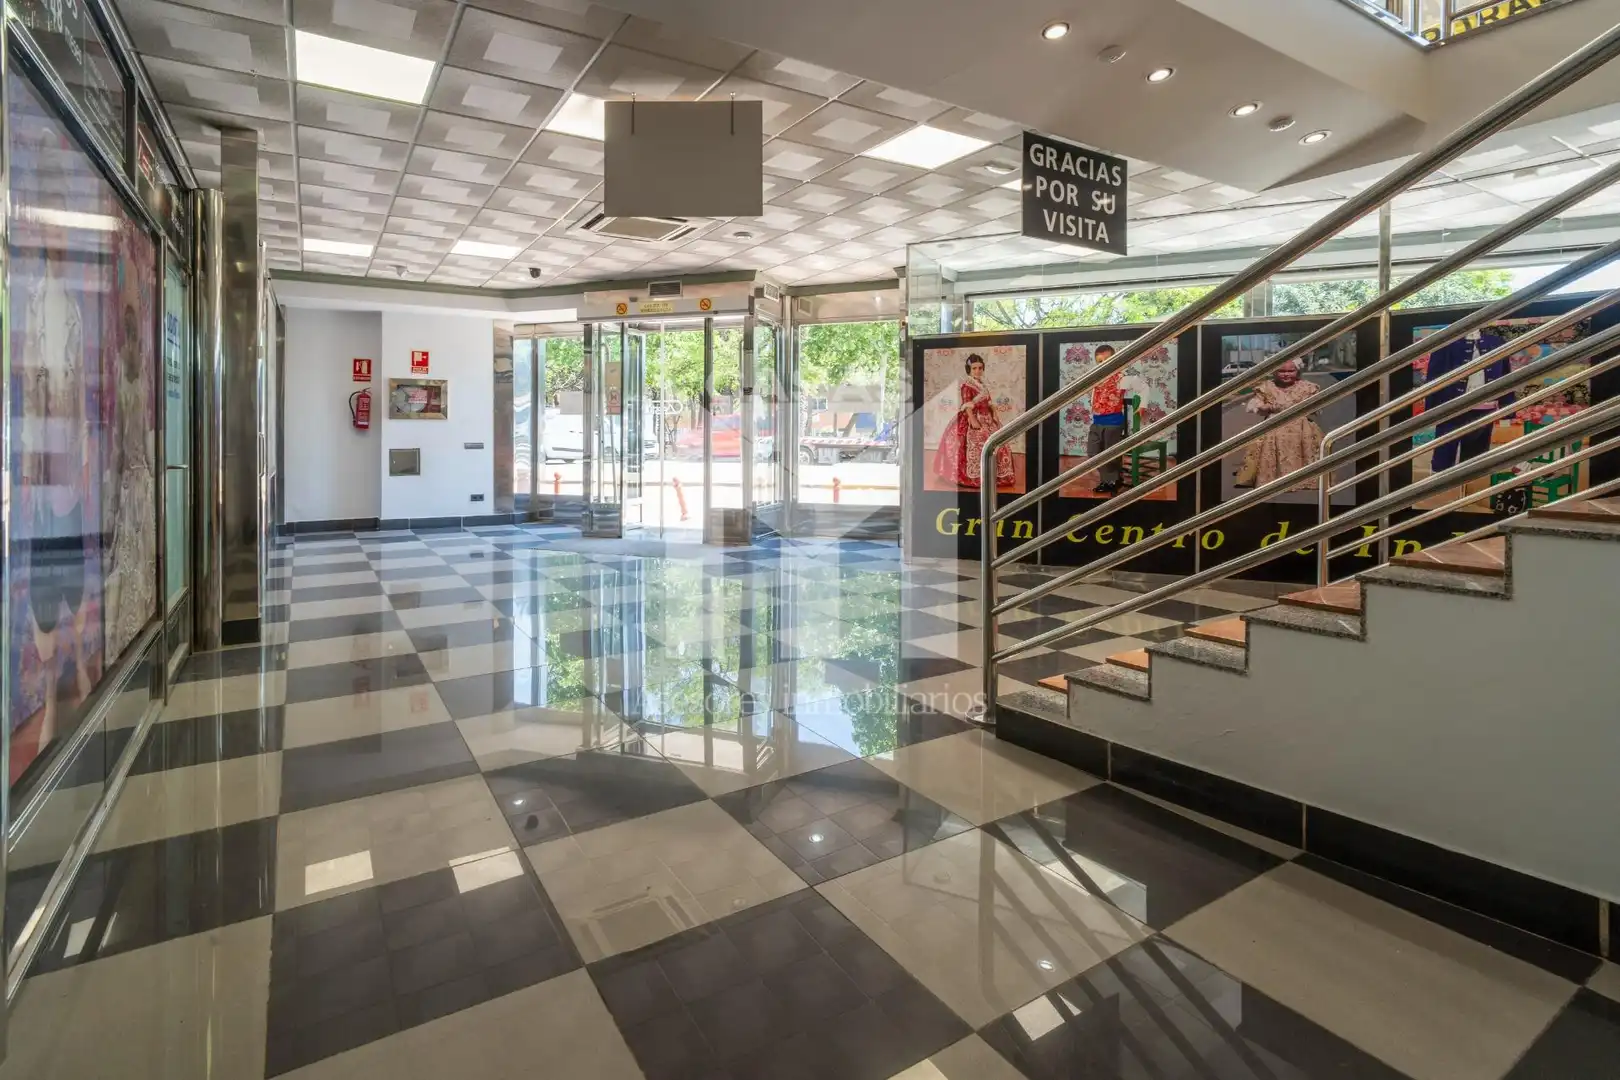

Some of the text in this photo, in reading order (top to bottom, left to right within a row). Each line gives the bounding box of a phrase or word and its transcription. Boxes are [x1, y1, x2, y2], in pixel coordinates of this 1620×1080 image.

[1029, 143, 1122, 187] GRACIAS
[1036, 175, 1116, 215] POR SU
[1043, 208, 1109, 244] VISITA
[1260, 520, 1314, 555] d
